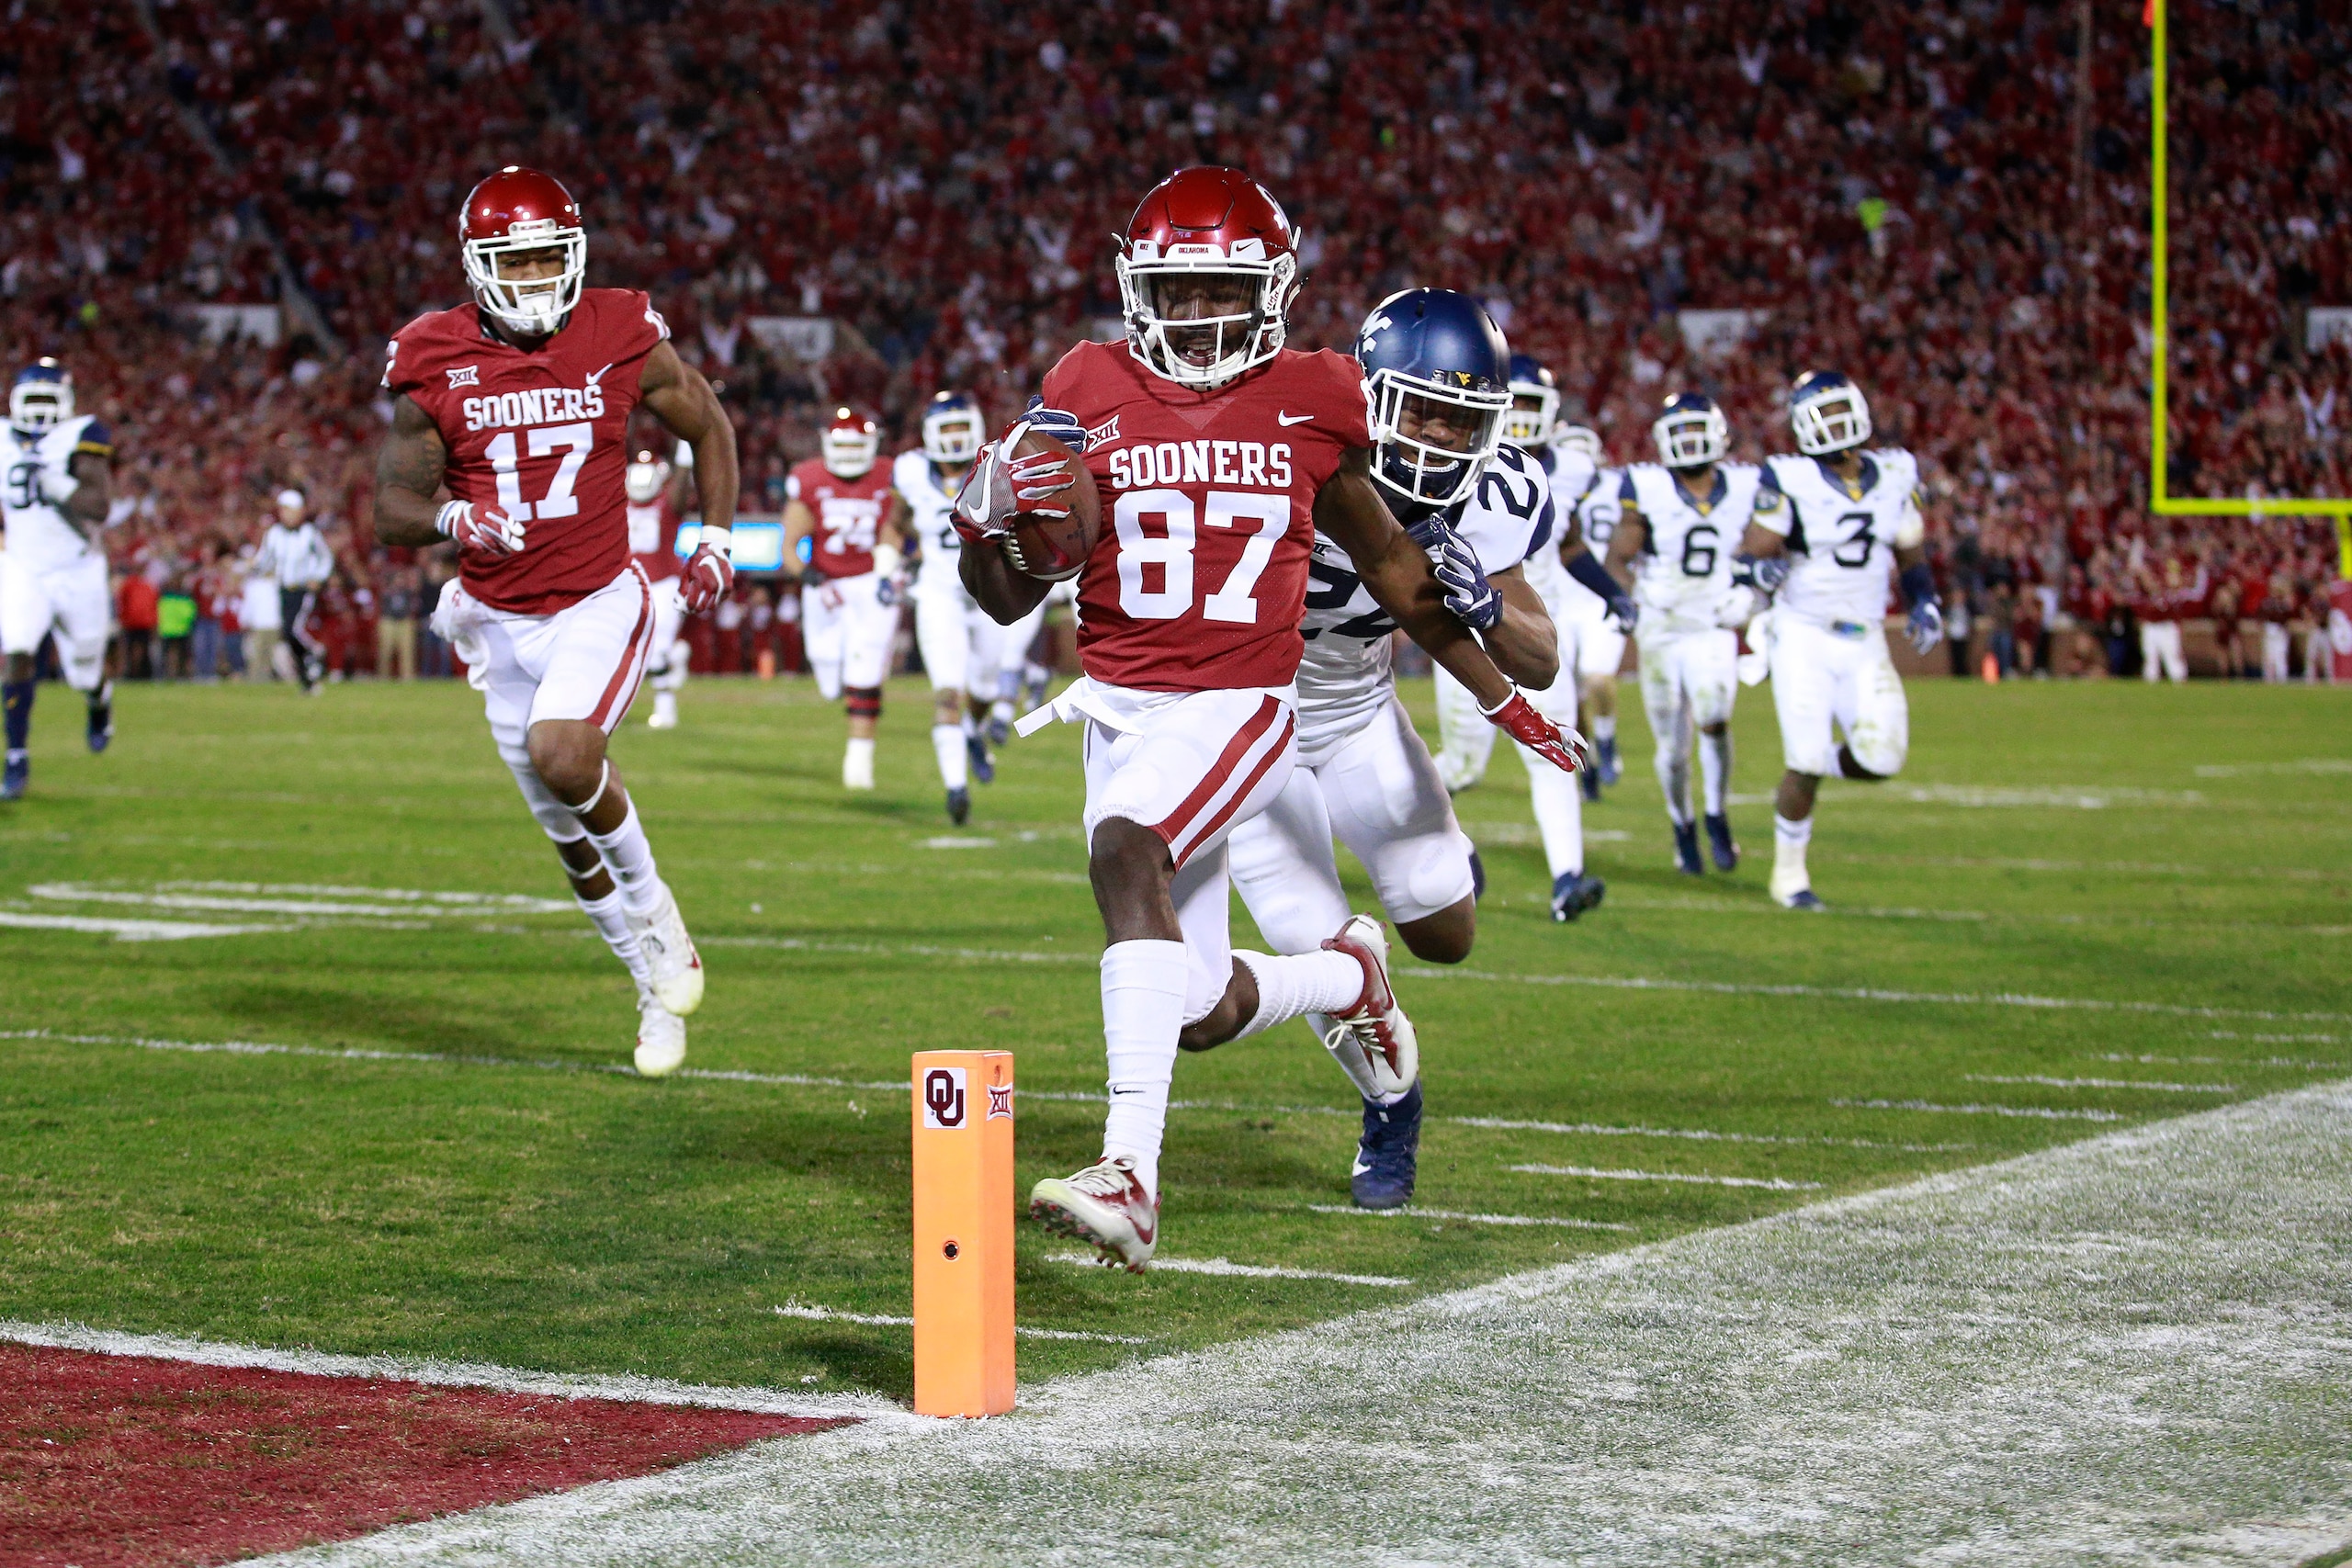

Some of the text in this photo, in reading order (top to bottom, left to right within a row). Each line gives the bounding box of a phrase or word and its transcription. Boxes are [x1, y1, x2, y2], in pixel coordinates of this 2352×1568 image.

[1179, 246, 1209, 254] OKLAHOMA
[463, 384, 605, 432] SOONERS
[484, 422, 594, 522] 17
[1109, 439, 1293, 489] SOONERS
[1113, 489, 1292, 624] 87
[1681, 525, 1719, 577] 6
[1833, 513, 1876, 568] 3
[926, 1070, 964, 1127] OU
[989, 1087, 1012, 1118] XII
